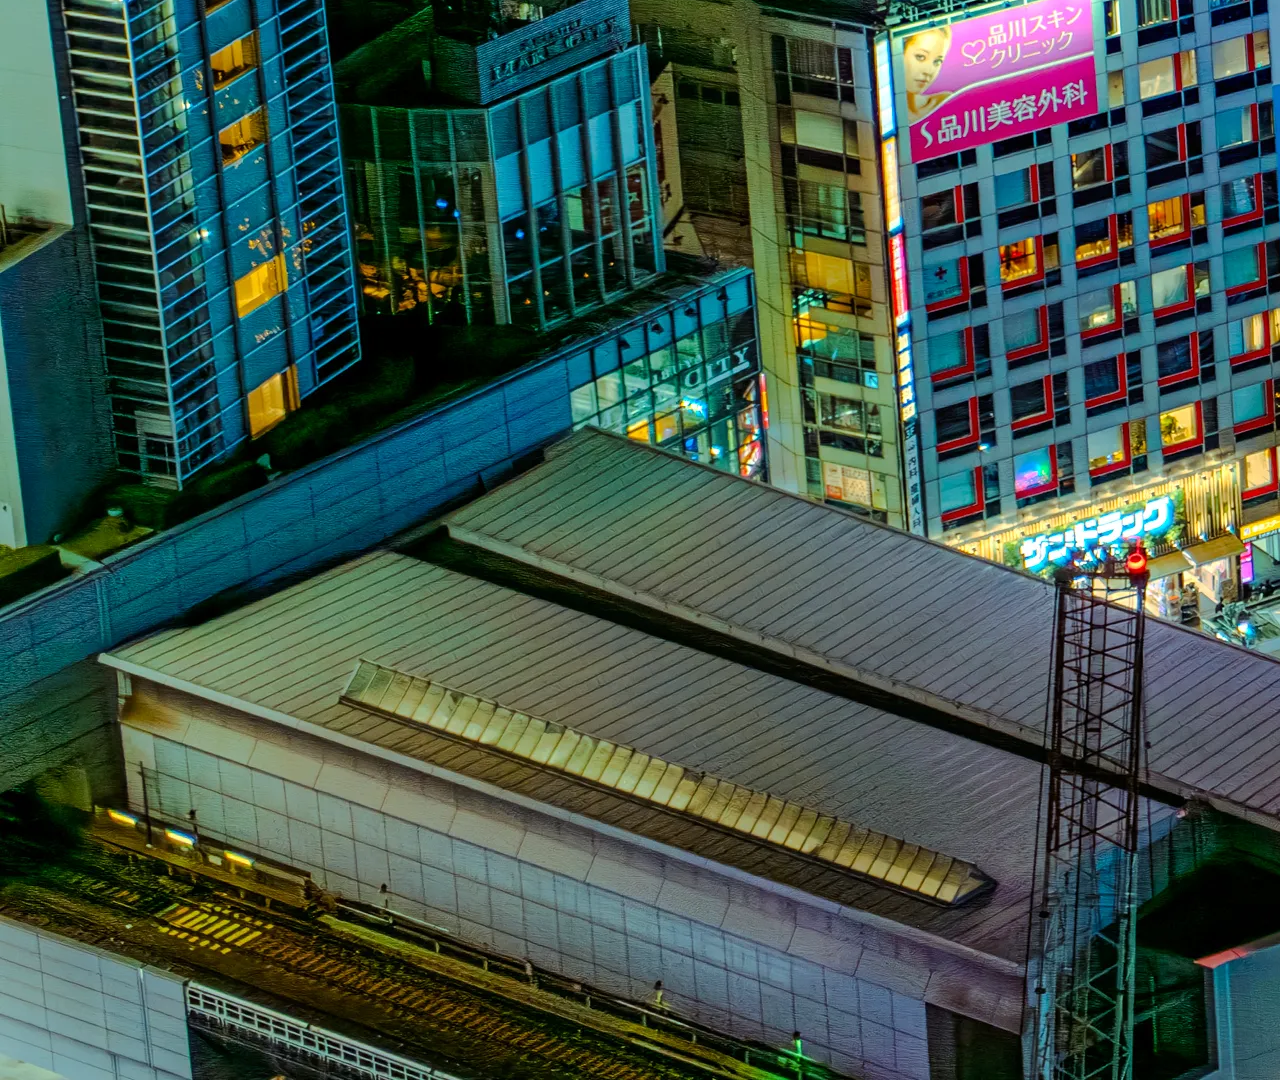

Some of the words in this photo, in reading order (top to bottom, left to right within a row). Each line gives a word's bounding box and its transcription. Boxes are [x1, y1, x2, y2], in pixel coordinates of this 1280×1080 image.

[987, 6, 1083, 47] 品川スキン
[989, 30, 1074, 69] クリニック
[937, 78, 1088, 144] 品川美容外科
